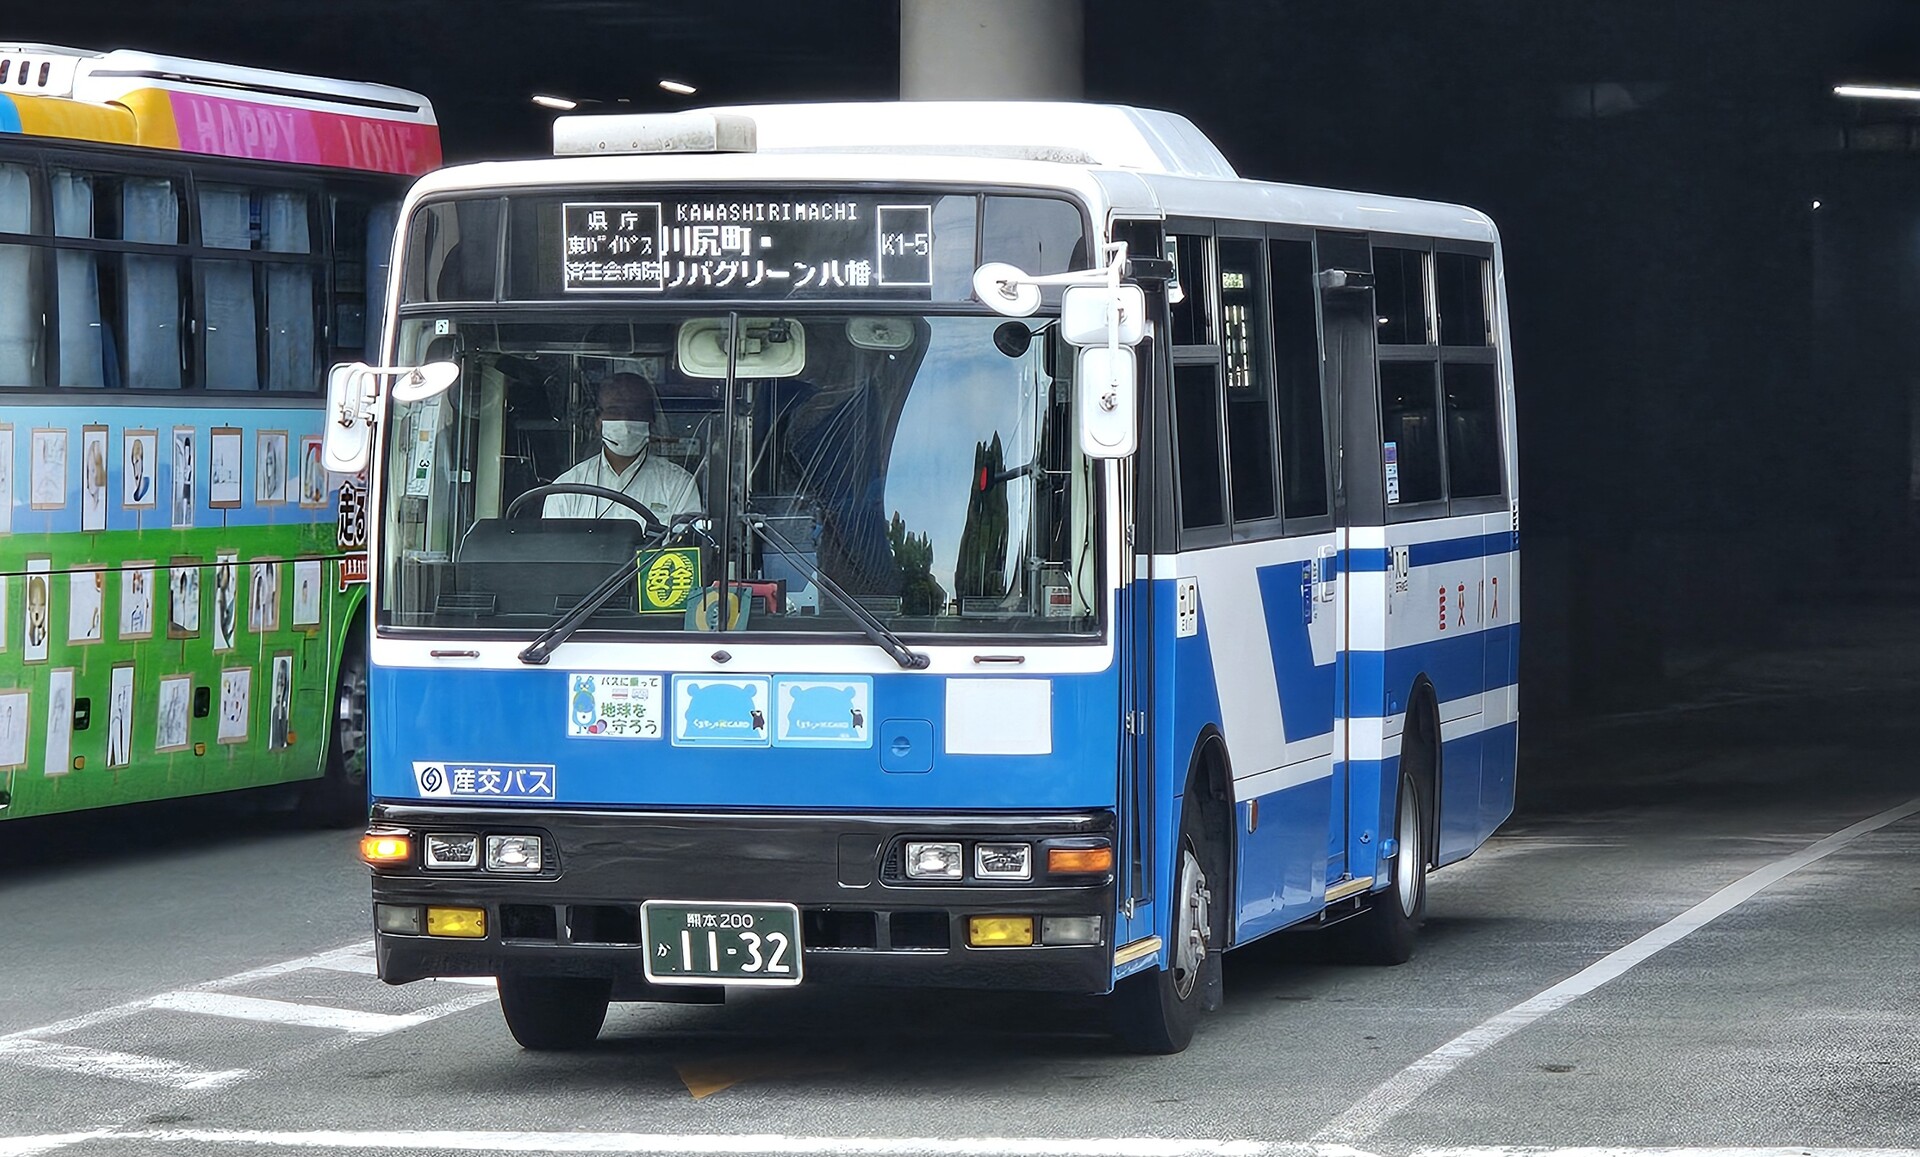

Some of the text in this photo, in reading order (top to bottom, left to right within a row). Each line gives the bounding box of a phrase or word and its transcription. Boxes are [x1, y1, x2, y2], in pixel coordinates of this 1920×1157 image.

[191, 98, 412, 178] HAPPY LOVE
[676, 202, 858, 222] KAWASHIRIMACHI
[881, 232, 928, 256] K1-5
[566, 260, 661, 281] 済生会病院
[663, 259, 872, 288] リバグリーン八幡
[648, 567, 693, 592] 安全
[600, 702, 647, 718] 地球を
[612, 719, 657, 735] 守ろう
[453, 767, 551, 794] 産交バス
[656, 930, 790, 973] か 11-32
